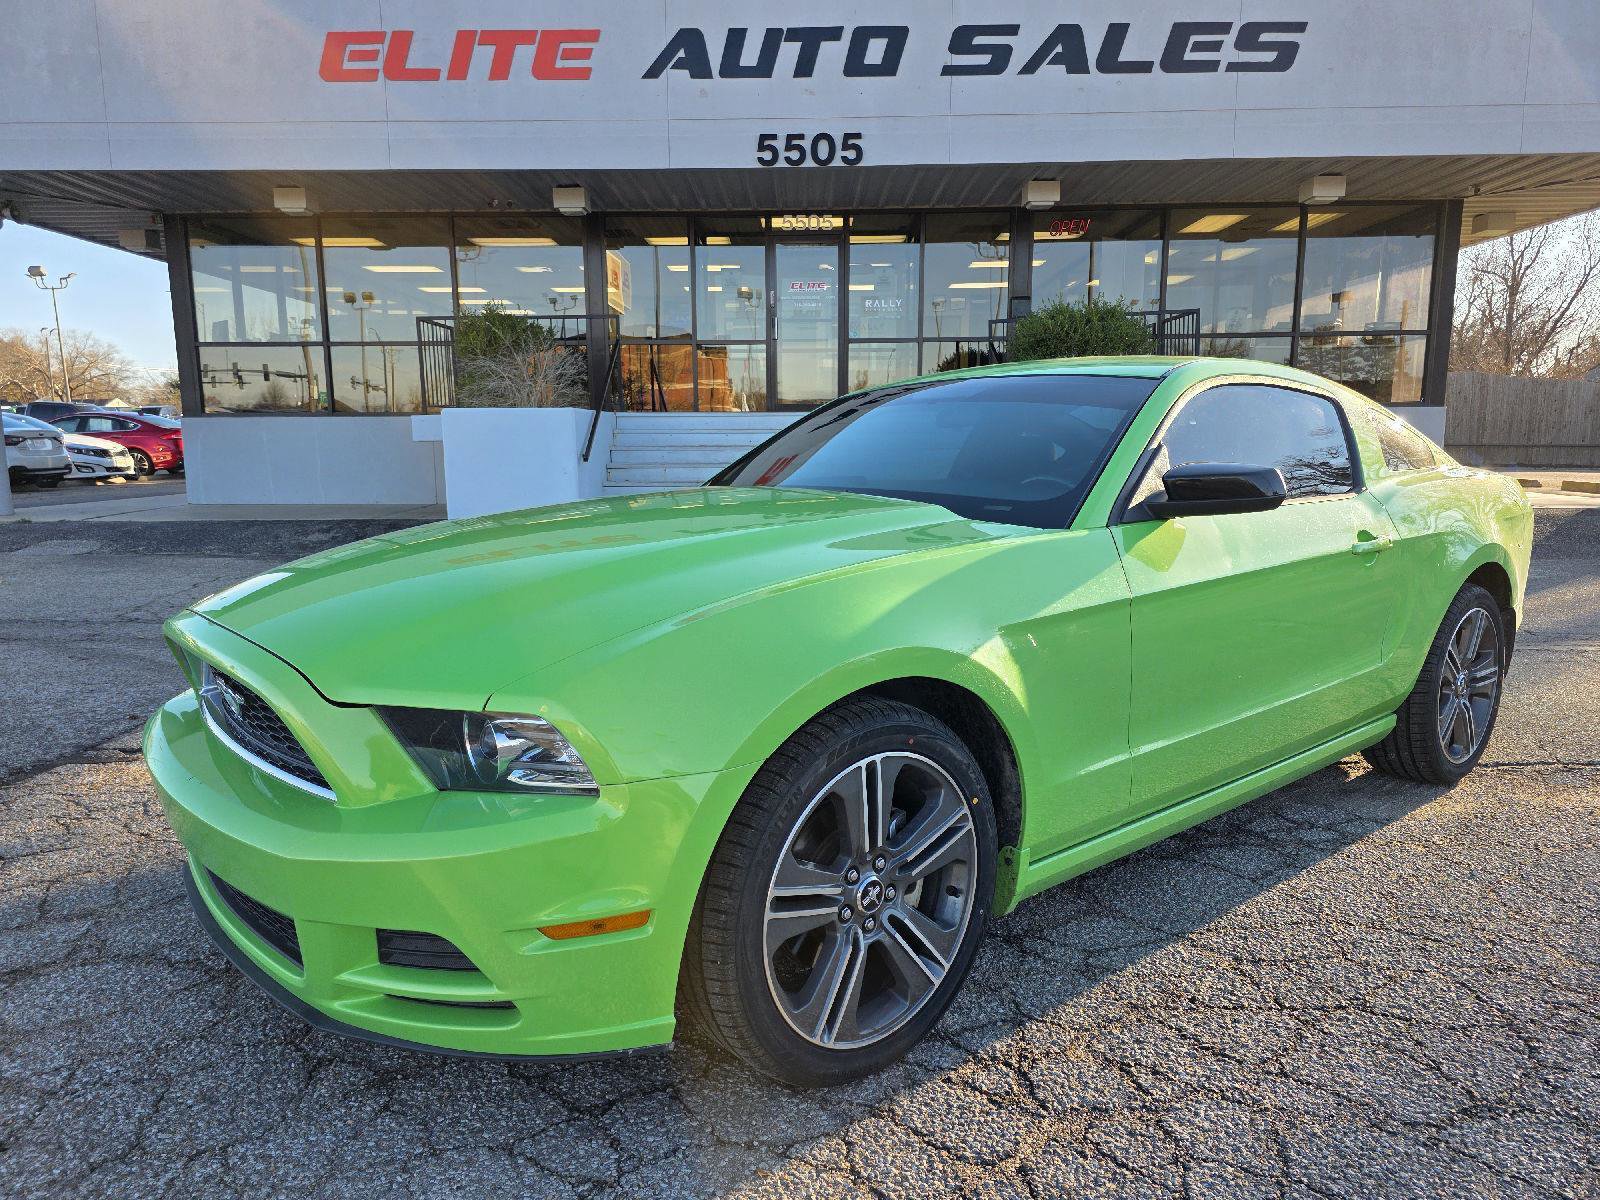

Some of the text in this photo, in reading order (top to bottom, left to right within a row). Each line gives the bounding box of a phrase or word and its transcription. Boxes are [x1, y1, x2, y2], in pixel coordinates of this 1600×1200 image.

[318, 21, 1309, 83] ELITE AUTO SALES
[756, 132, 864, 167] 5505
[781, 214, 833, 231] 5505
[1049, 218, 1092, 236] OPEN
[865, 299, 903, 308] RALLY
